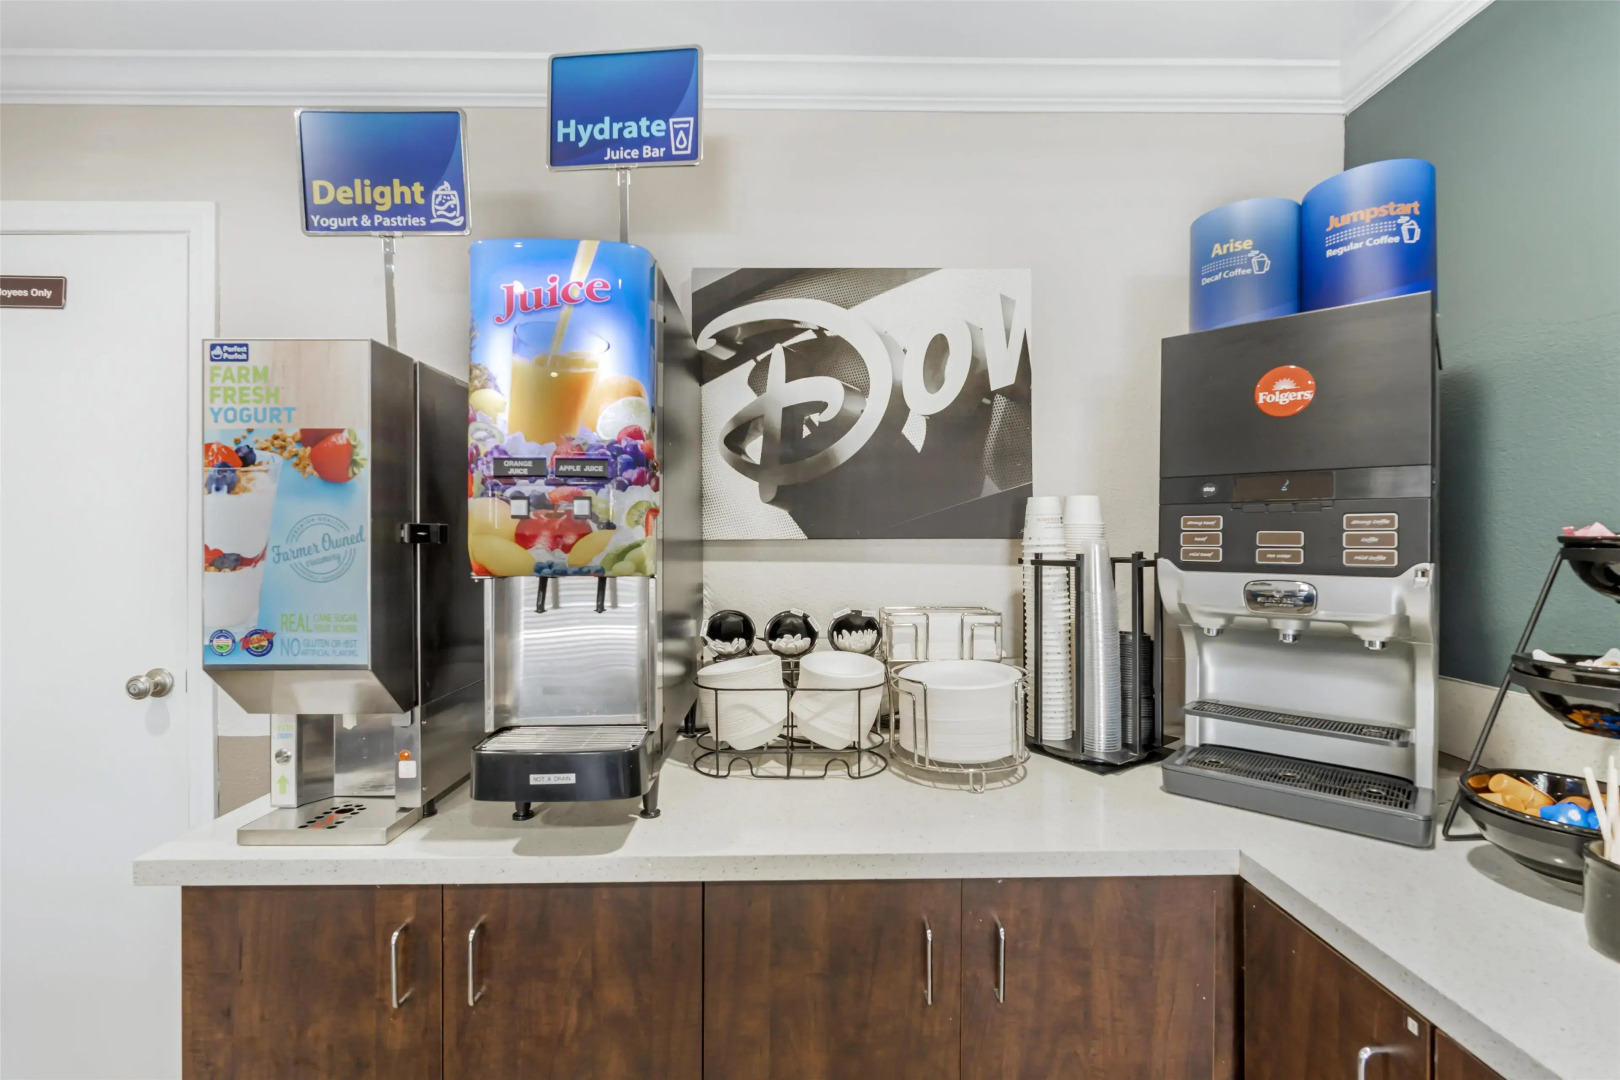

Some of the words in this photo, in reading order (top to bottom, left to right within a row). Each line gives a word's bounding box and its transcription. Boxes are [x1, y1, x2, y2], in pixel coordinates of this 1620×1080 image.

[557, 116, 666, 148] Hydrate
[604, 147, 639, 160] Juice
[642, 145, 666, 158] Bar
[312, 178, 425, 211] Delight
[311, 214, 357, 229] Yogurt
[360, 215, 371, 227] &
[374, 214, 426, 227] Pastries
[1326, 201, 1420, 232] Jumpstart
[1211, 237, 1253, 258] Arise
[1326, 240, 1364, 258] Regular
[1365, 235, 1400, 248] Coffee
[1201, 272, 1222, 286] Decaf
[1223, 267, 1252, 279] Coffee
[30, 288, 52, 299] Only
[494, 274, 611, 324] Juice
[222, 345, 248, 353] Perfect
[222, 352, 248, 360] Parfait
[209, 365, 269, 384] FARM
[209, 386, 280, 404] FRESH
[1257, 390, 1314, 405] Folgers
[209, 406, 296, 424] YOGURT
[271, 543, 320, 564] Farmer
[321, 525, 365, 551] Owned
[281, 612, 313, 633] REAL
[281, 638, 300, 657] NO
